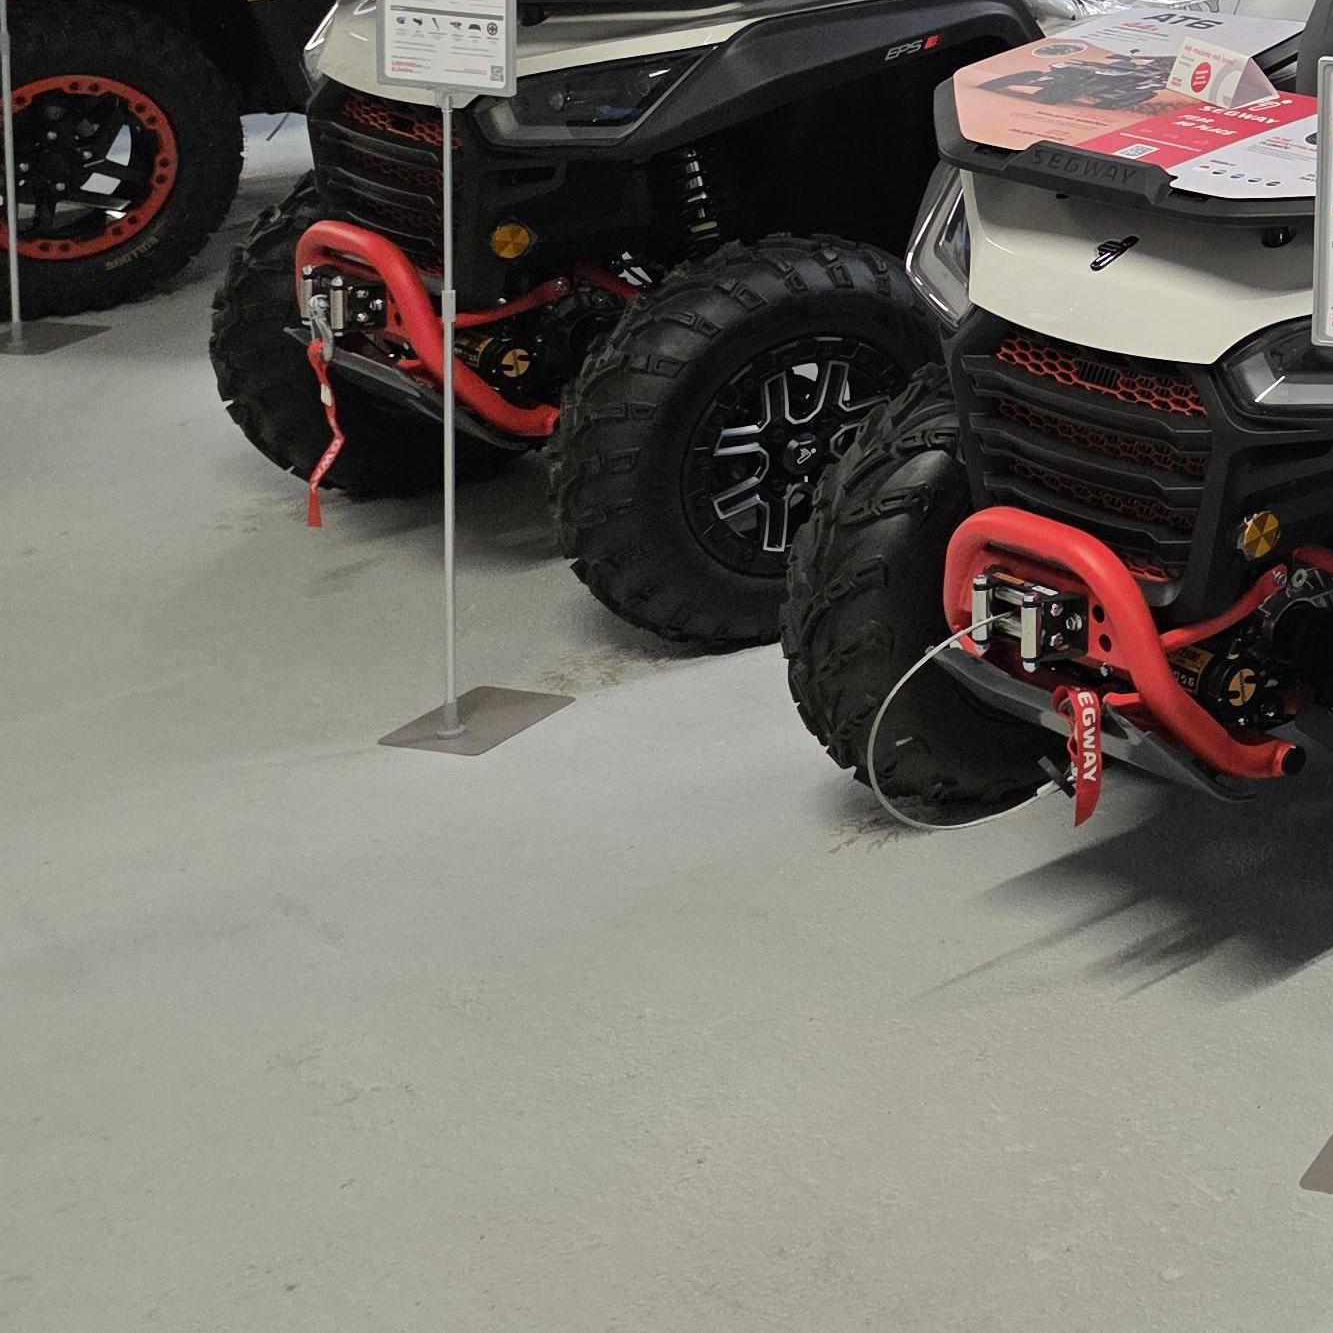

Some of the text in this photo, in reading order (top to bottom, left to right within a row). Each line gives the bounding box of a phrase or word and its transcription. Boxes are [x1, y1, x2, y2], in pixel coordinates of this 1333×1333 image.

[1141, 12, 1227, 30] AT6
[884, 39, 924, 62] EPS
[1198, 105, 1281, 125] SEGWAY
[1029, 148, 1137, 184] SEGWAY
[1077, 688, 1097, 783] EGWAY
